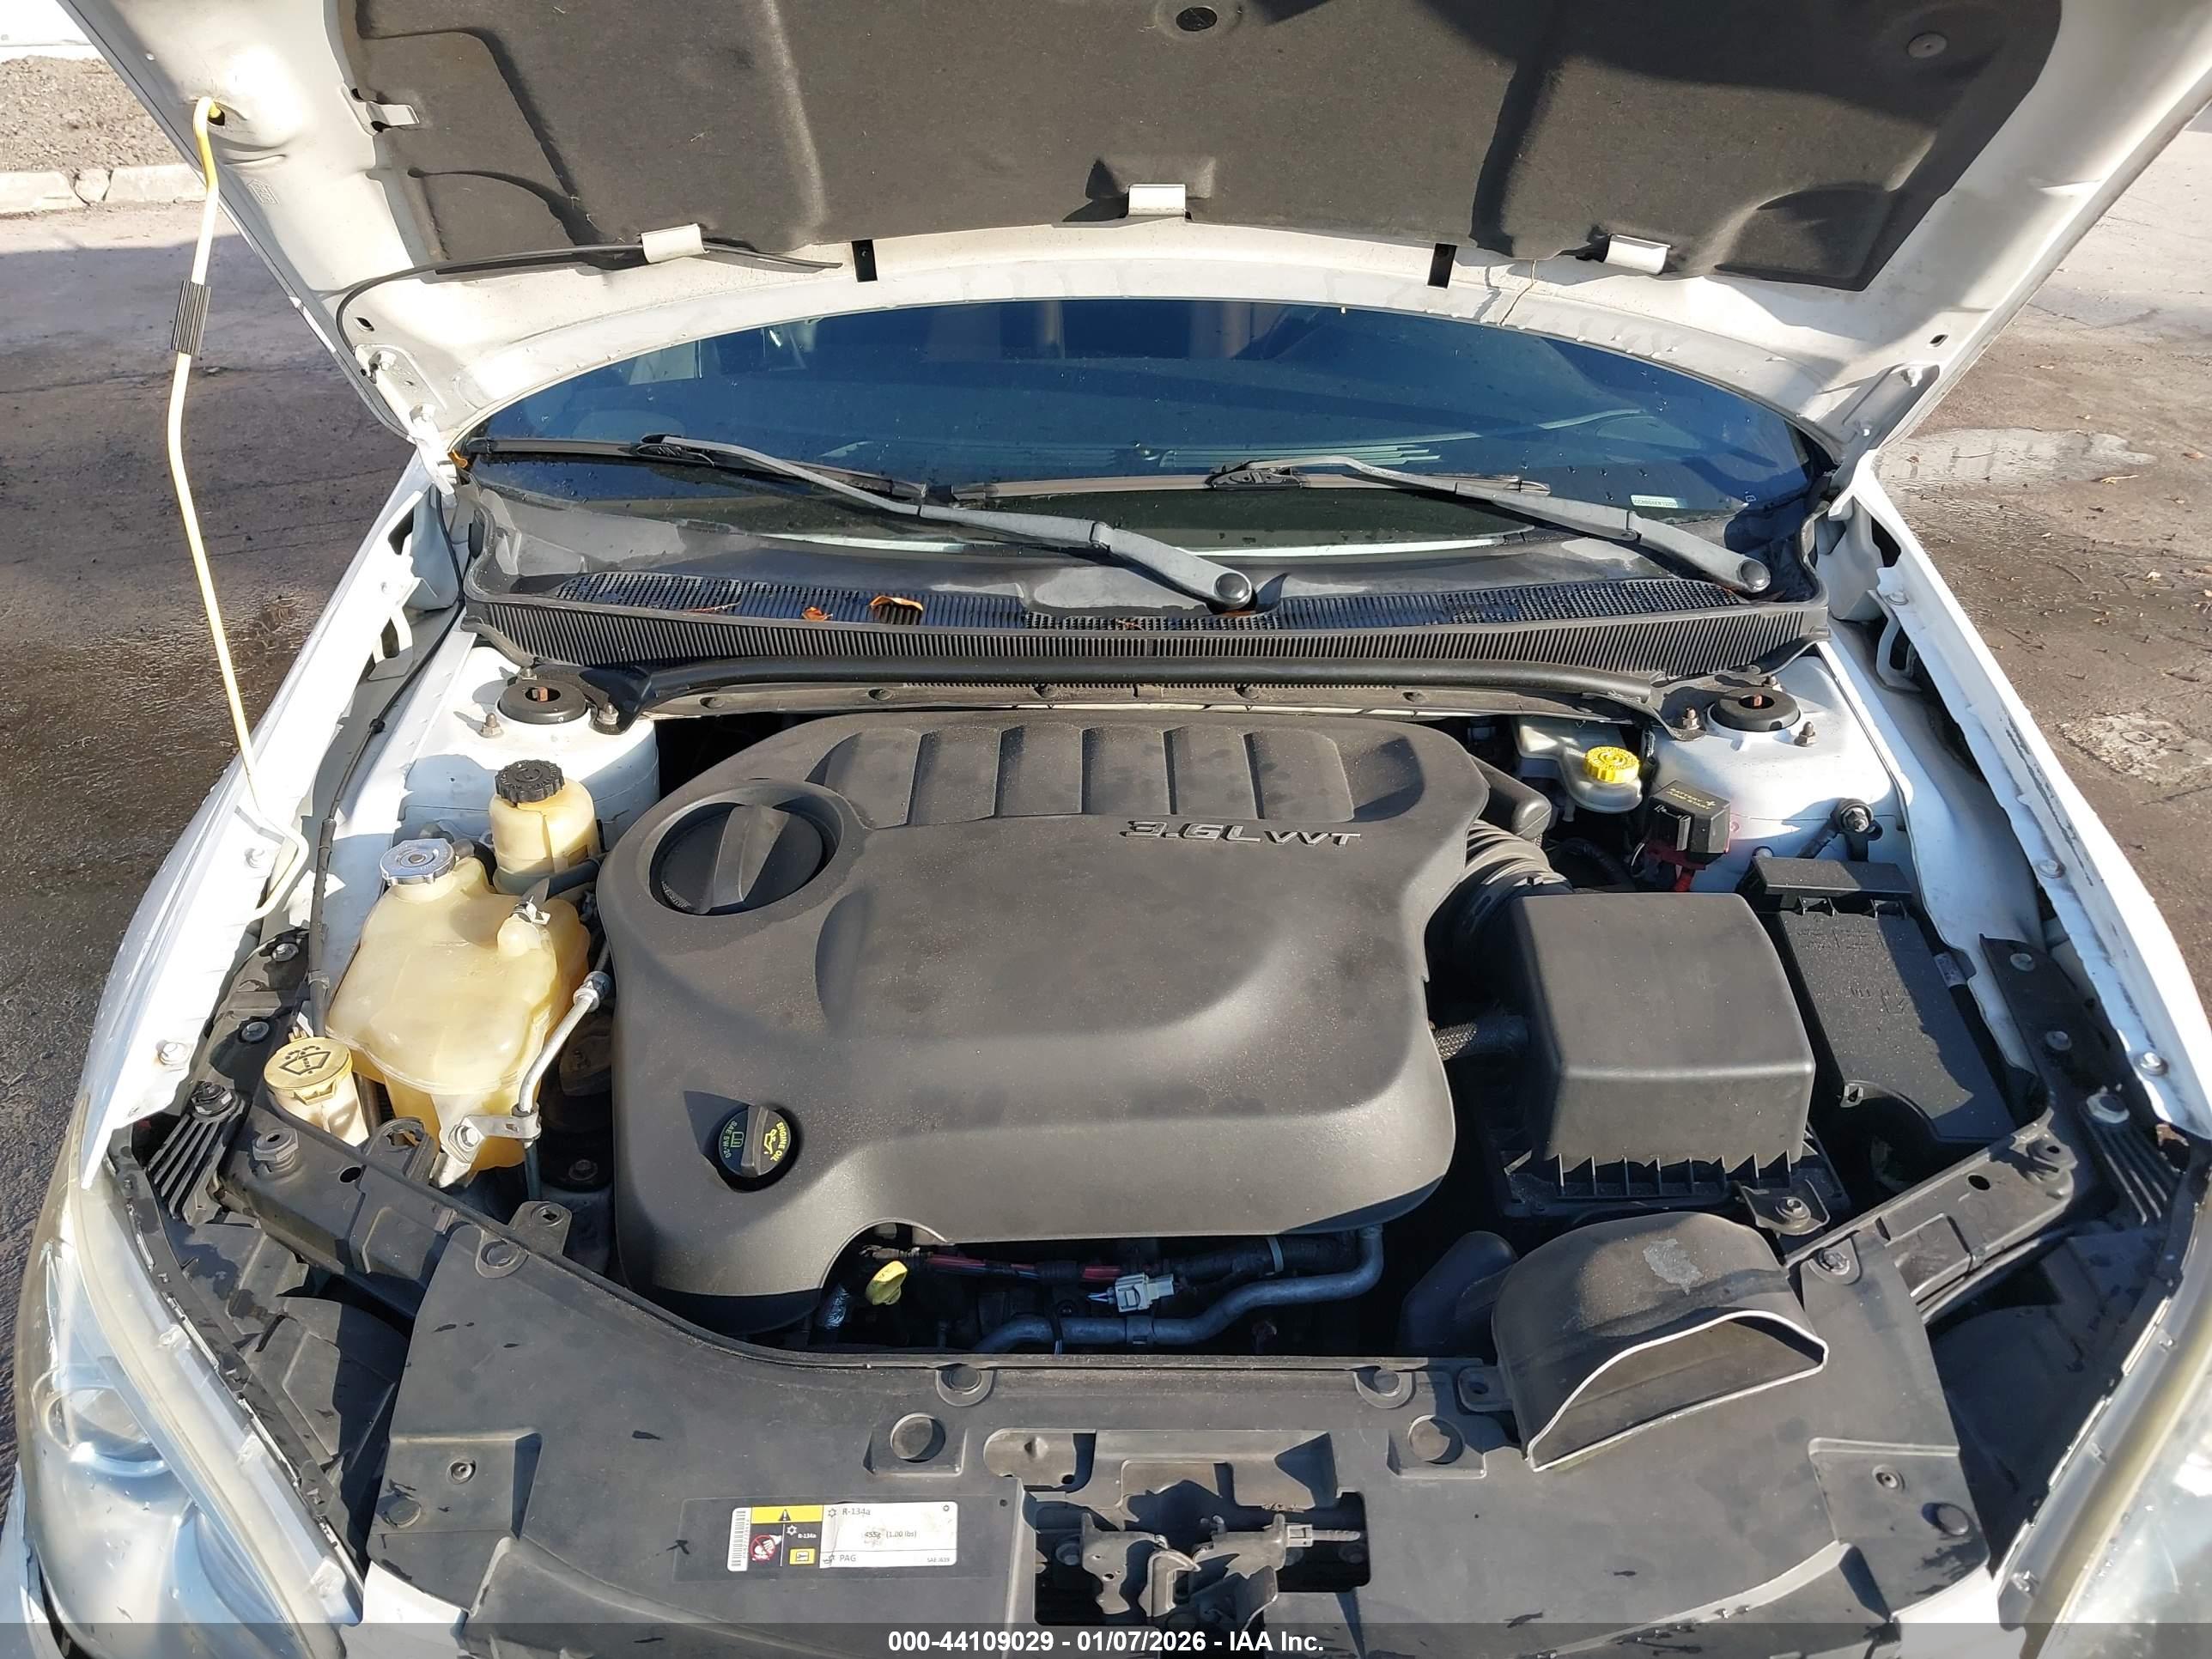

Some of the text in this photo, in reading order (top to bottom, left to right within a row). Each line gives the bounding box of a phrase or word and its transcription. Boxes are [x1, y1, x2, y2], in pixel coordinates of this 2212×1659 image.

[1122, 820, 1361, 845] 3.6L VVT
[725, 1121, 738, 1134] SAE
[770, 1121, 787, 1162] ENGINE OIL
[842, 1507, 871, 1516] R-134a
[839, 1553, 857, 1563] PAG
